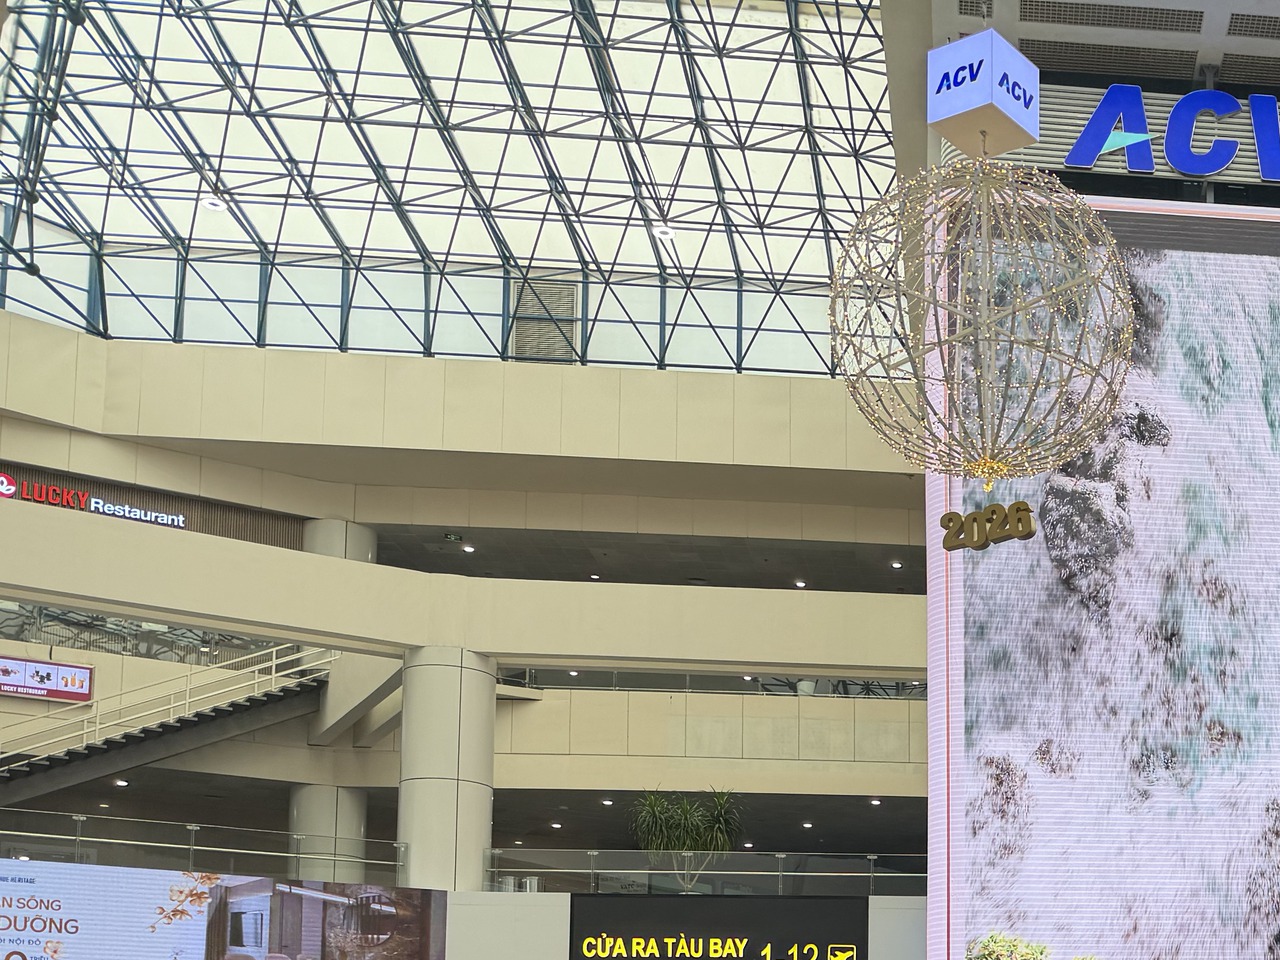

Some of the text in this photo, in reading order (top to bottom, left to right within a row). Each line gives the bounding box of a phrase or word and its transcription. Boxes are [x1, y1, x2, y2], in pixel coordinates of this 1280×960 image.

[935, 59, 984, 95] ACV
[998, 72, 1034, 110] ACV
[21, 481, 185, 527] LUCKY Restaurant
[940, 501, 1037, 552] 2026
[16, 895, 62, 912] SỐNG
[0, 914, 79, 935] DƯỠNG
[582, 932, 748, 958] CỬA RA TÀU BAY
